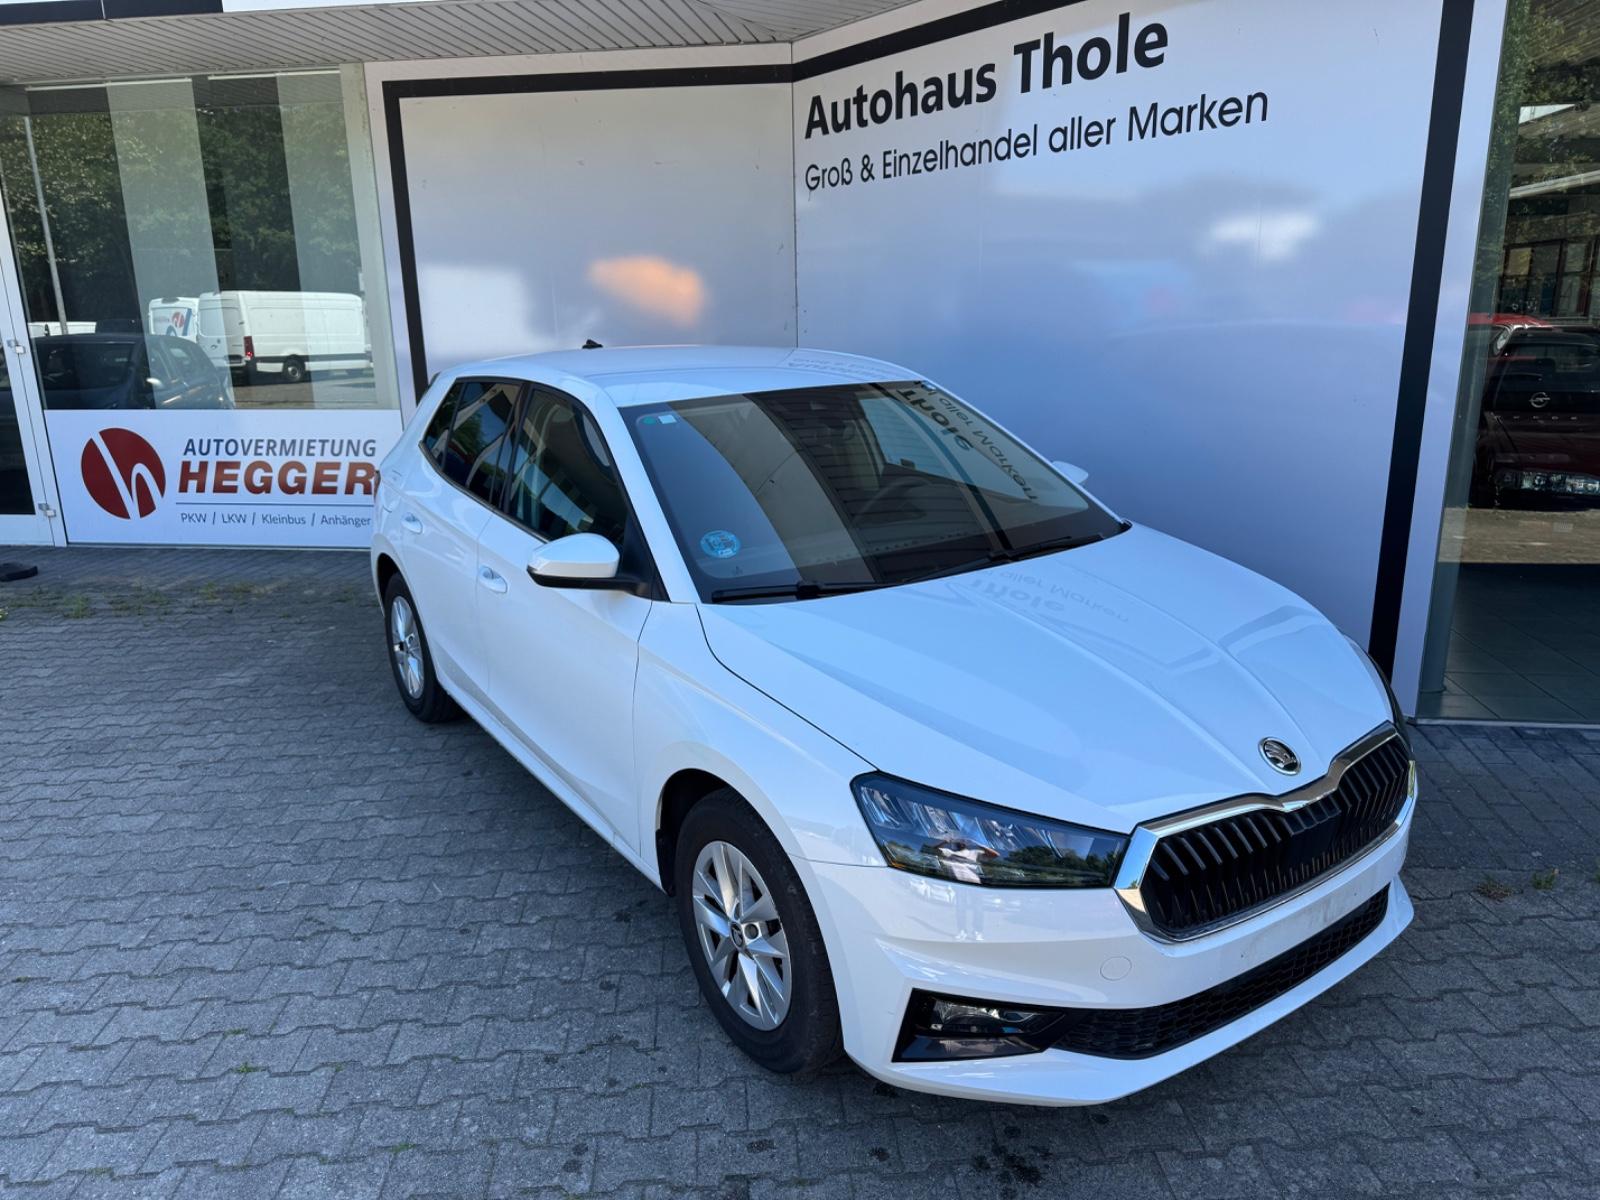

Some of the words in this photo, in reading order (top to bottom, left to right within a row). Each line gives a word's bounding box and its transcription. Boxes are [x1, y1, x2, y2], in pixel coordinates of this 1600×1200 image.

[805, 63, 997, 139] Autohaus
[1013, 12, 1168, 93] Thole
[805, 157, 853, 191] Groß
[860, 154, 876, 183] &
[882, 123, 1038, 180] Einzelhandel
[1048, 115, 1117, 153] aller
[1127, 90, 1269, 142] Marken
[183, 438, 377, 457] AUTOVERMIETUNG
[178, 460, 376, 495] HEGGER
[180, 512, 207, 524] PKW
[221, 513, 247, 525] LKW
[261, 513, 307, 526] Kleinbus
[320, 514, 372, 528] Anhänger
